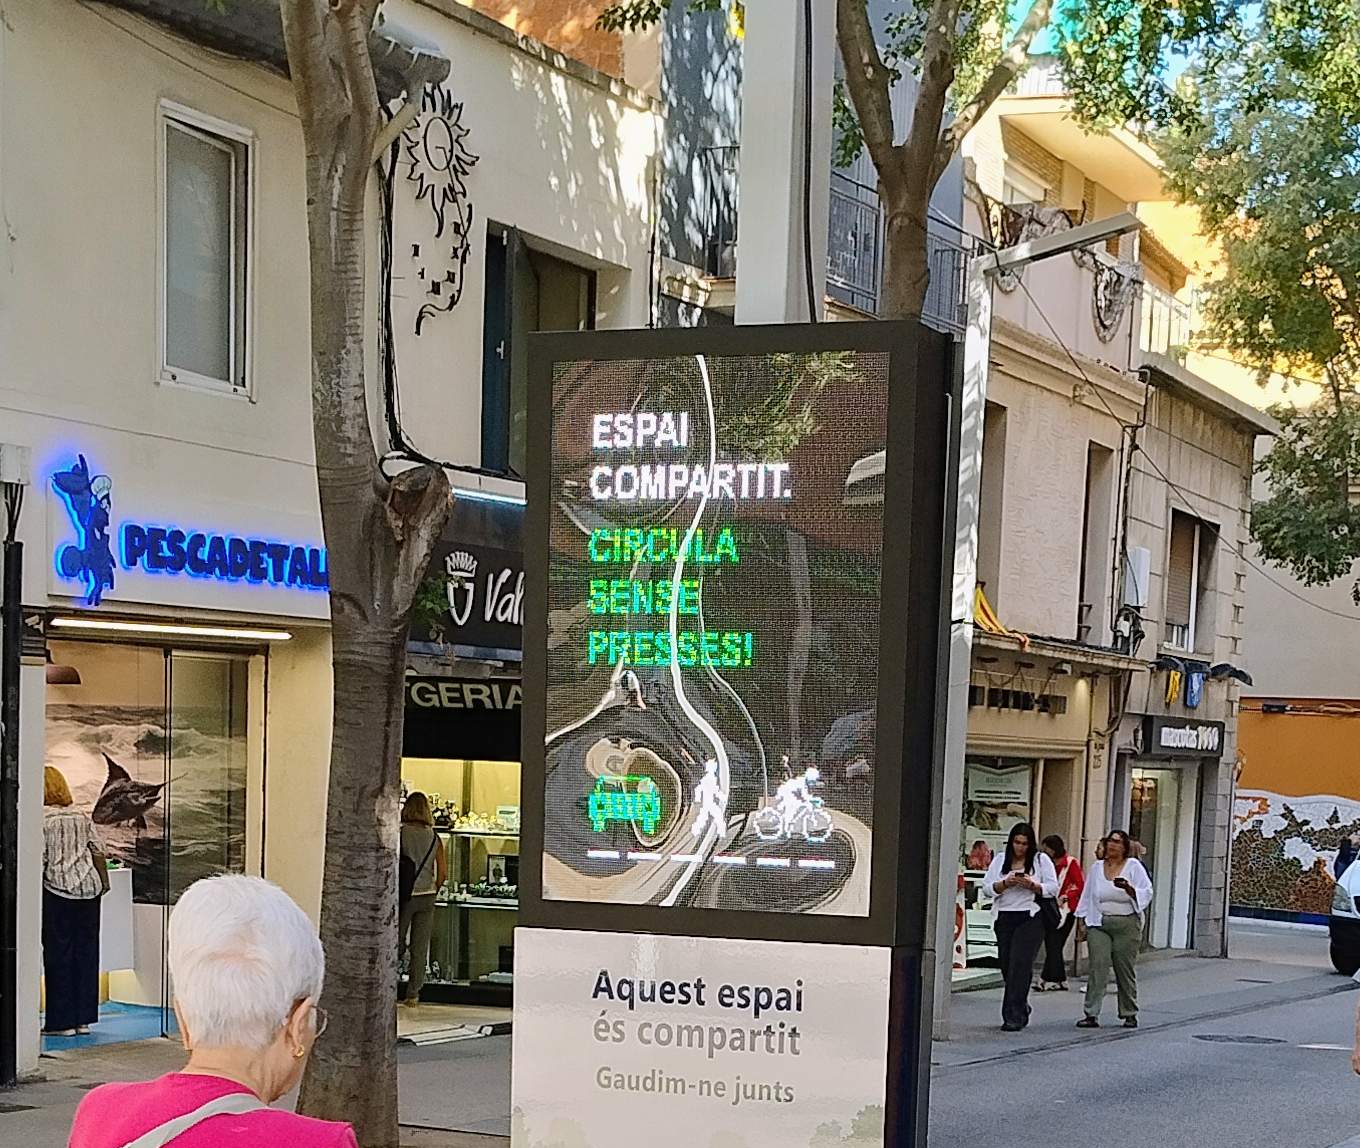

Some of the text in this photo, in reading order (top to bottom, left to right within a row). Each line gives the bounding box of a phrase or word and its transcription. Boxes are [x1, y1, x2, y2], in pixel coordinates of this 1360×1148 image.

[592, 411, 688, 447] ESPAI
[590, 463, 792, 500] COMPARTIT.
[588, 527, 740, 563] CIRCULA
[485, 568, 524, 625] Val
[588, 579, 700, 614] SENSE
[588, 631, 752, 667] PRESSES!
[405, 681, 523, 709] GERIA
[592, 969, 804, 1019] Aquest espai
[593, 1009, 801, 1059] és compartit
[596, 1066, 794, 1106] Gaudim-ne junts
